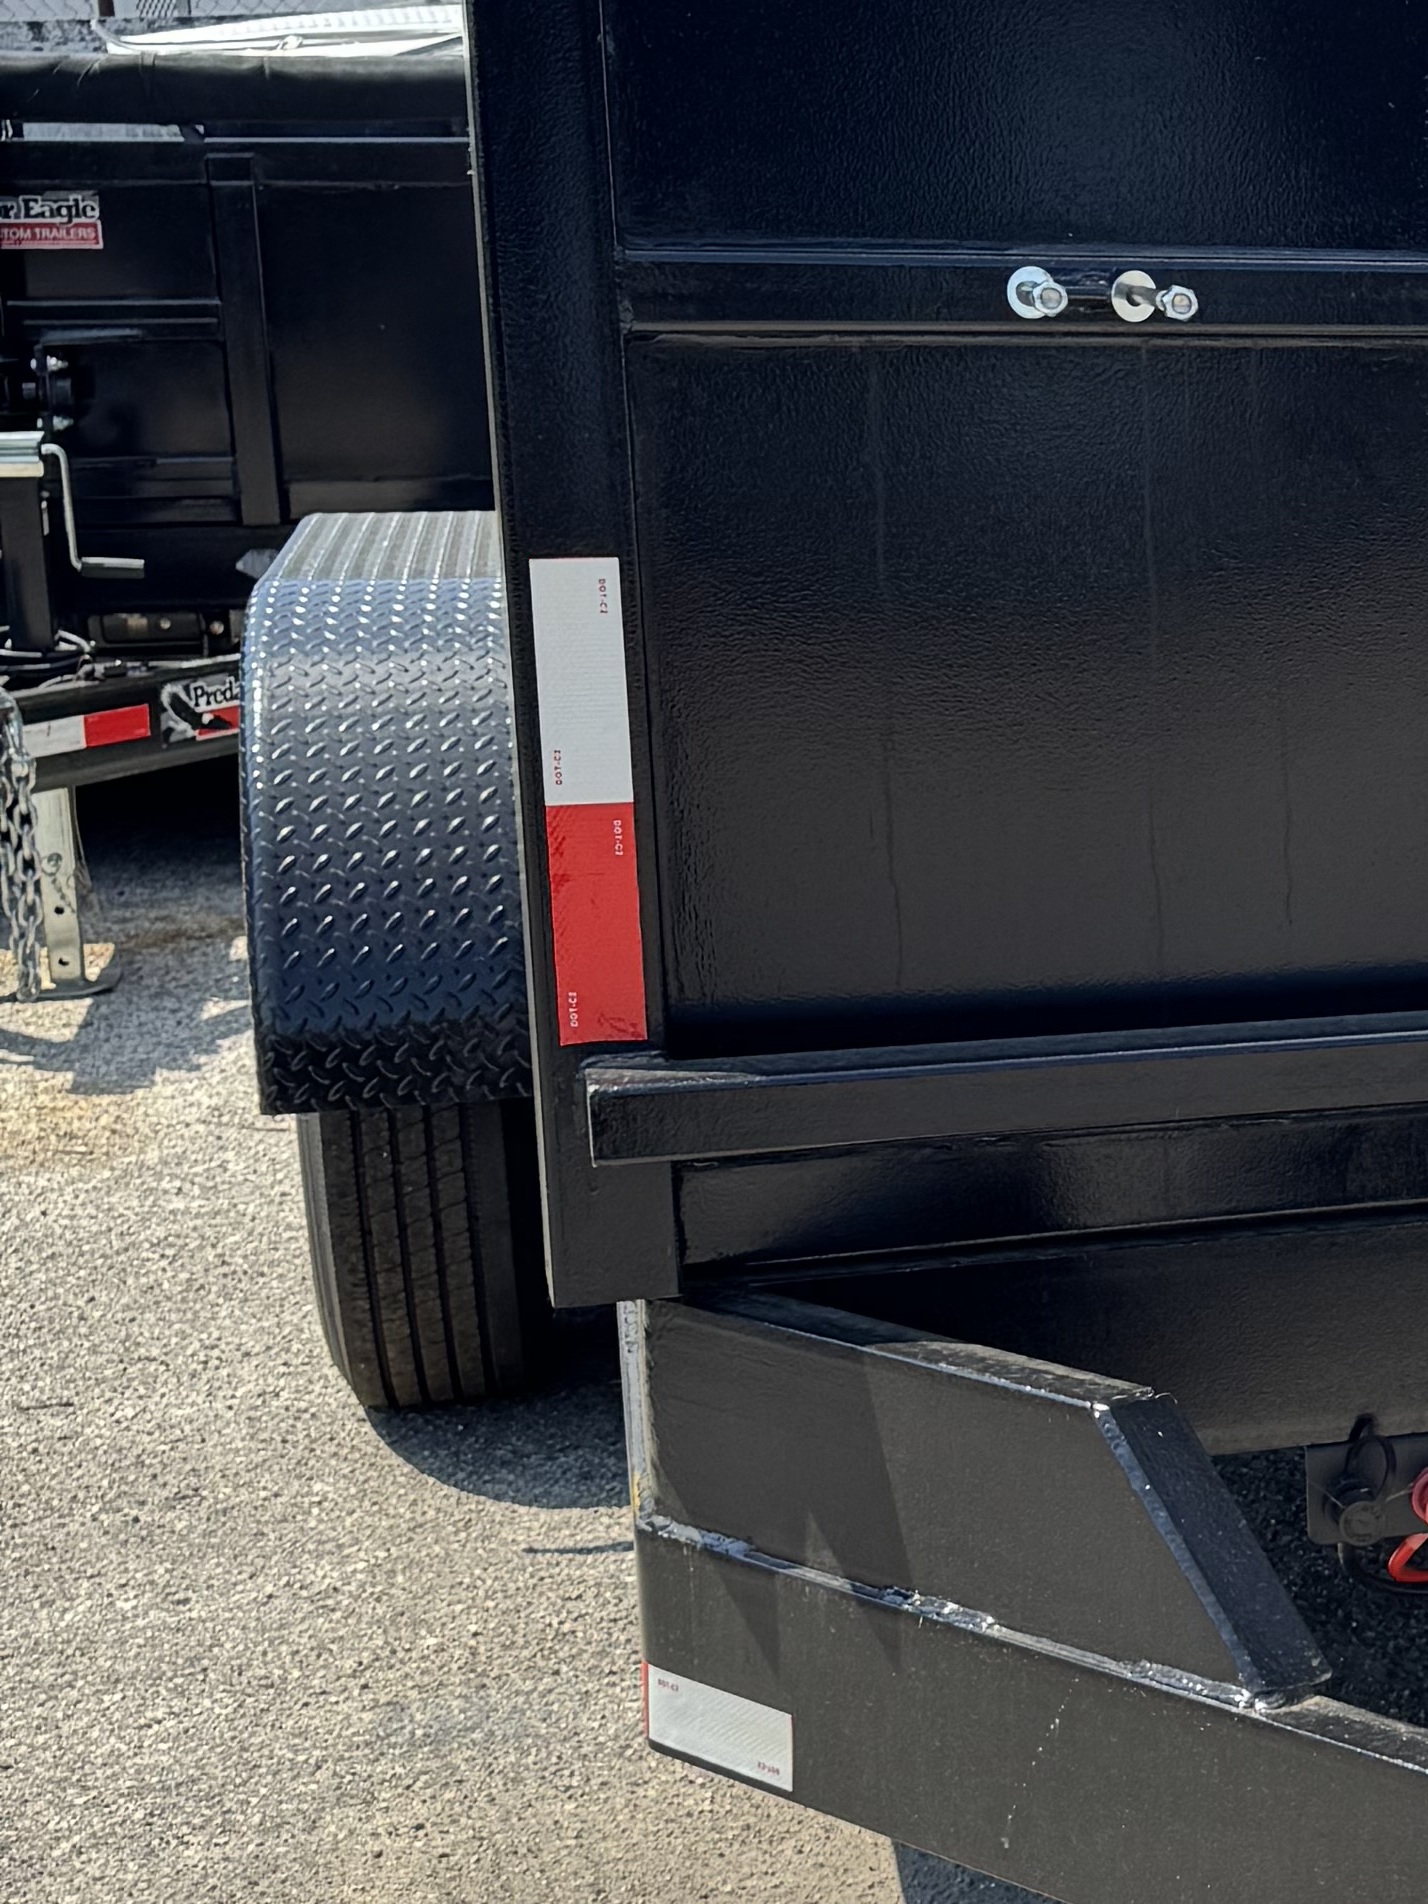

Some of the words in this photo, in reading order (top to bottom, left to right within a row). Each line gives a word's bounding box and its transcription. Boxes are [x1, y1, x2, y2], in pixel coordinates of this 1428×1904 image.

[19, 195, 100, 226] Eagle
[34, 226, 97, 241] TRAILERS
[597, 578, 608, 615] DOT-C2
[554, 749, 562, 786] DOT-C2
[614, 819, 623, 857] DOT-C2
[569, 991, 578, 1028] DOT-C2
